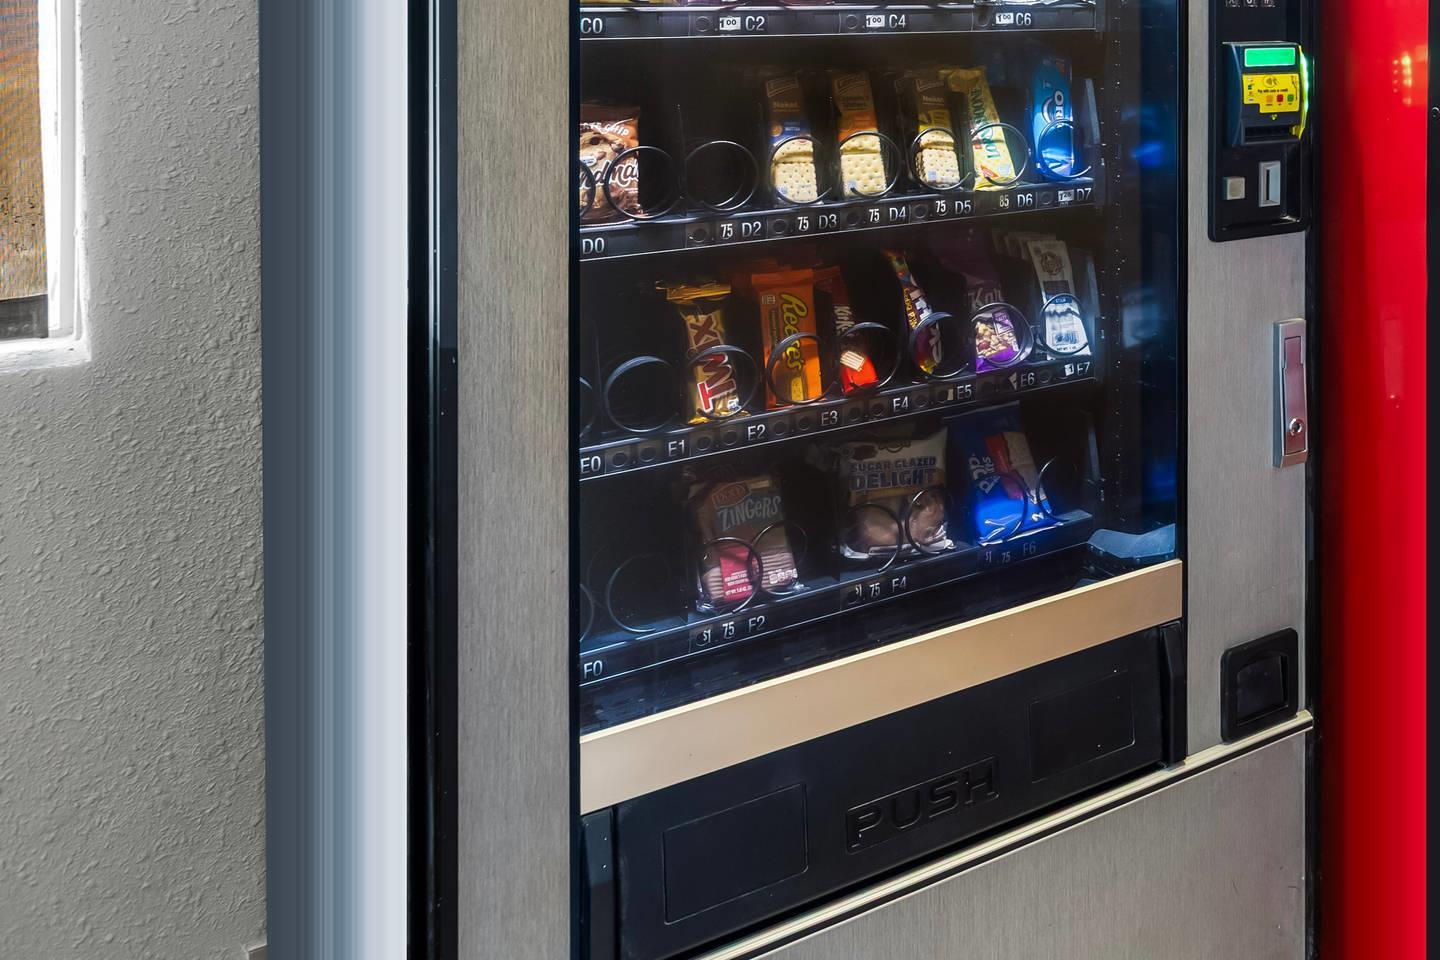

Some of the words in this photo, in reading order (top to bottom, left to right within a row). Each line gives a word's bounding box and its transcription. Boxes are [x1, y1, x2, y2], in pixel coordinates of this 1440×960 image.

[580, 18, 604, 34] C0
[746, 16, 765, 31] C2
[889, 13, 906, 28] C4
[1016, 12, 1032, 26] C6
[1000, 194, 1009, 208] 85
[1017, 194, 1033, 207] D6
[1076, 188, 1092, 201] D7
[869, 208, 880, 223] 75
[889, 206, 906, 220] D4
[935, 200, 946, 214] 75
[955, 200, 972, 215] D5
[720, 224, 734, 238] 75
[742, 222, 762, 238] D2
[797, 217, 809, 231] 75
[819, 214, 838, 228] D3
[582, 237, 606, 255] D0
[834, 305, 856, 337] KitK
[780, 292, 805, 370] Reese's
[688, 312, 737, 413] TWIX
[1076, 362, 1091, 376] E7
[1020, 372, 1035, 386] E6
[956, 385, 972, 400] E5
[893, 396, 909, 412] E4
[821, 410, 838, 426] E3
[748, 424, 766, 440] E2
[668, 440, 686, 456] E1
[580, 456, 601, 474] E0
[851, 459, 893, 473] SUGAR
[894, 456, 936, 468] GLAZED
[851, 468, 936, 490] DELIGHT
[1002, 551, 1011, 564] 75
[1023, 542, 1036, 556] F6
[870, 583, 880, 597] 75
[892, 576, 907, 592] F4
[722, 622, 735, 638] 75
[748, 616, 765, 632] F2
[583, 660, 604, 679] F0
[850, 757, 998, 849] PUSH
